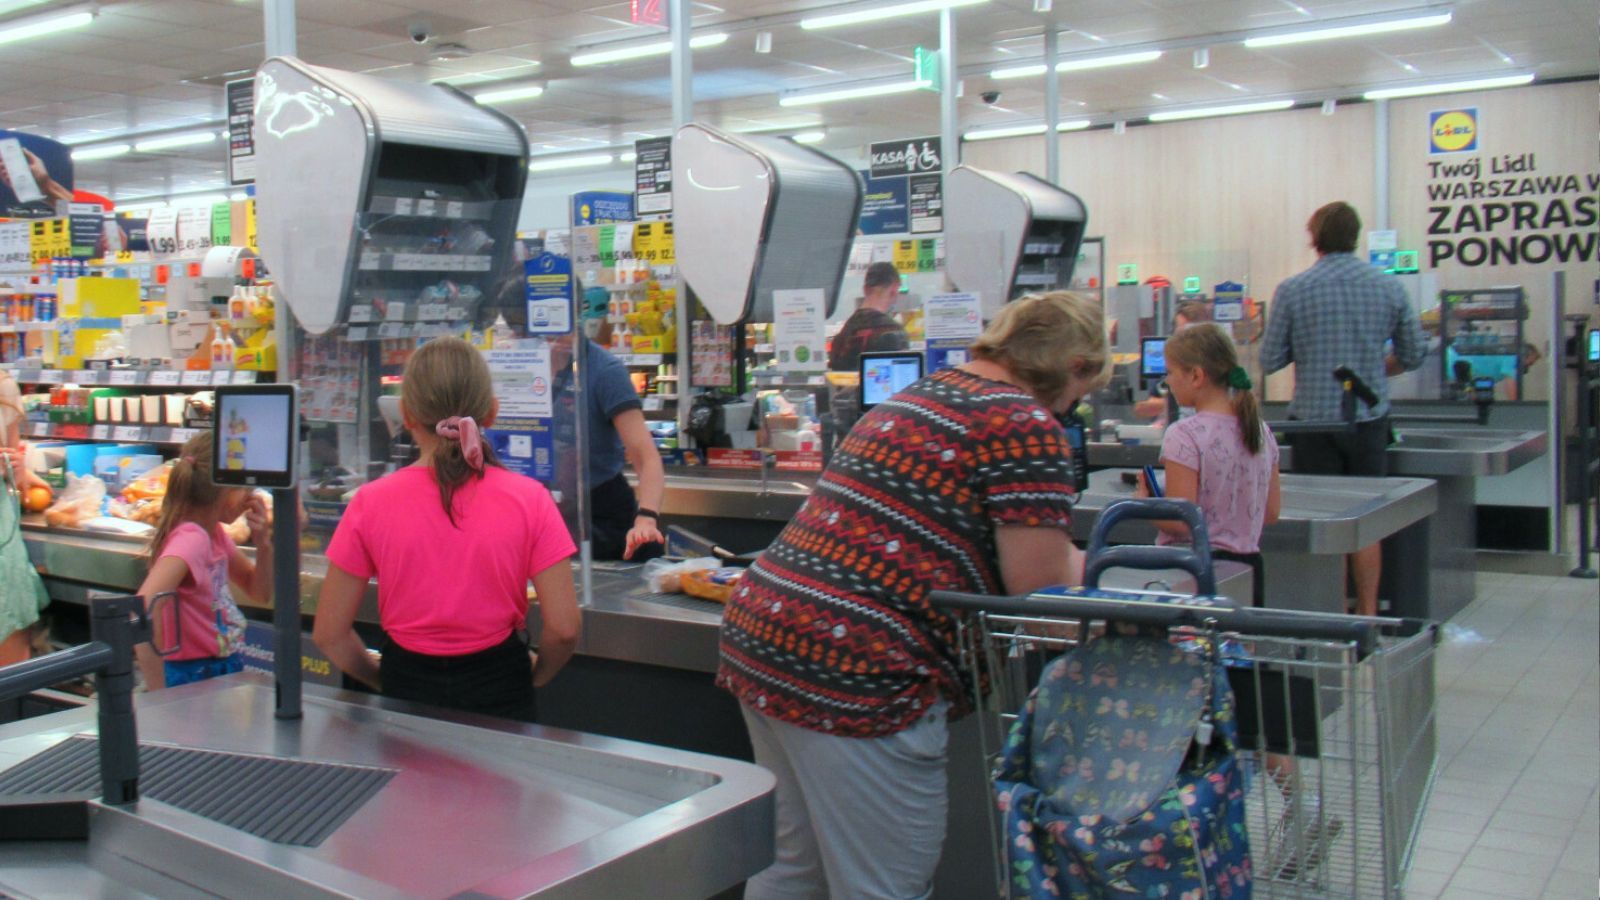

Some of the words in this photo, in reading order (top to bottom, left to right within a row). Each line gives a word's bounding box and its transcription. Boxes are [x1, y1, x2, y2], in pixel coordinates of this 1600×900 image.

[871, 150, 905, 165] KASA
[1428, 158, 1480, 181] Twój
[1491, 153, 1535, 174] Lidl
[1428, 174, 1580, 201] WARSZAWA
[1427, 196, 1598, 235] ZAPRAS
[1427, 231, 1600, 268] PONOW
[301, 655, 330, 675] PLUS
